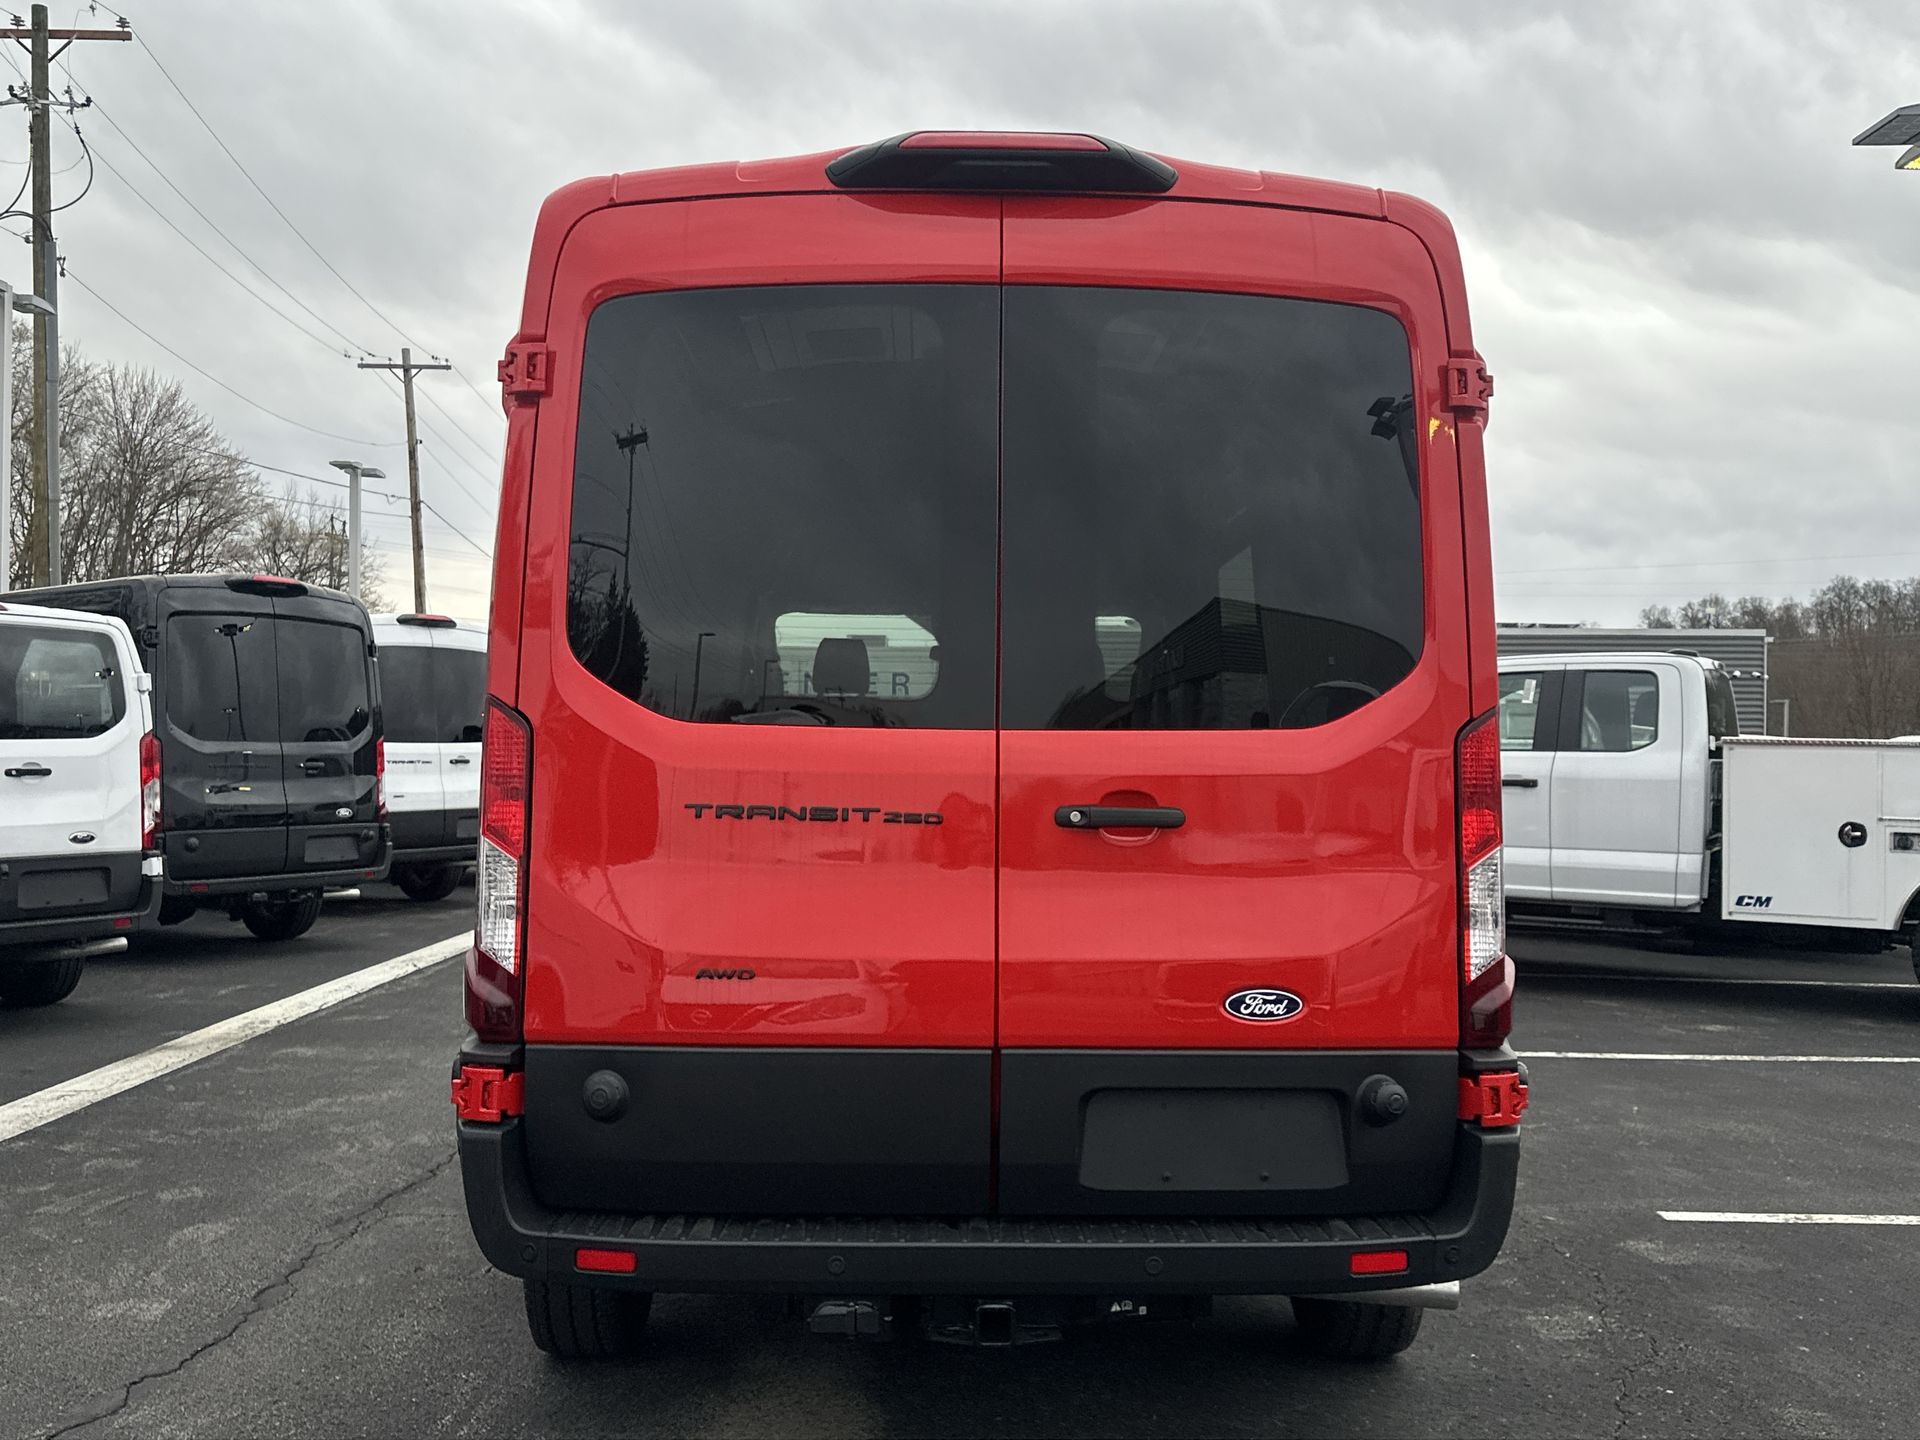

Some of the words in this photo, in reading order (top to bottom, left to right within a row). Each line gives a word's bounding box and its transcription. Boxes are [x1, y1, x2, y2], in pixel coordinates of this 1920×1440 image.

[684, 803, 881, 823] TRANSIT
[883, 811, 944, 825] 250
[1735, 895, 1773, 908] CM
[695, 967, 756, 981] AWD
[1240, 993, 1289, 1015] Ford
